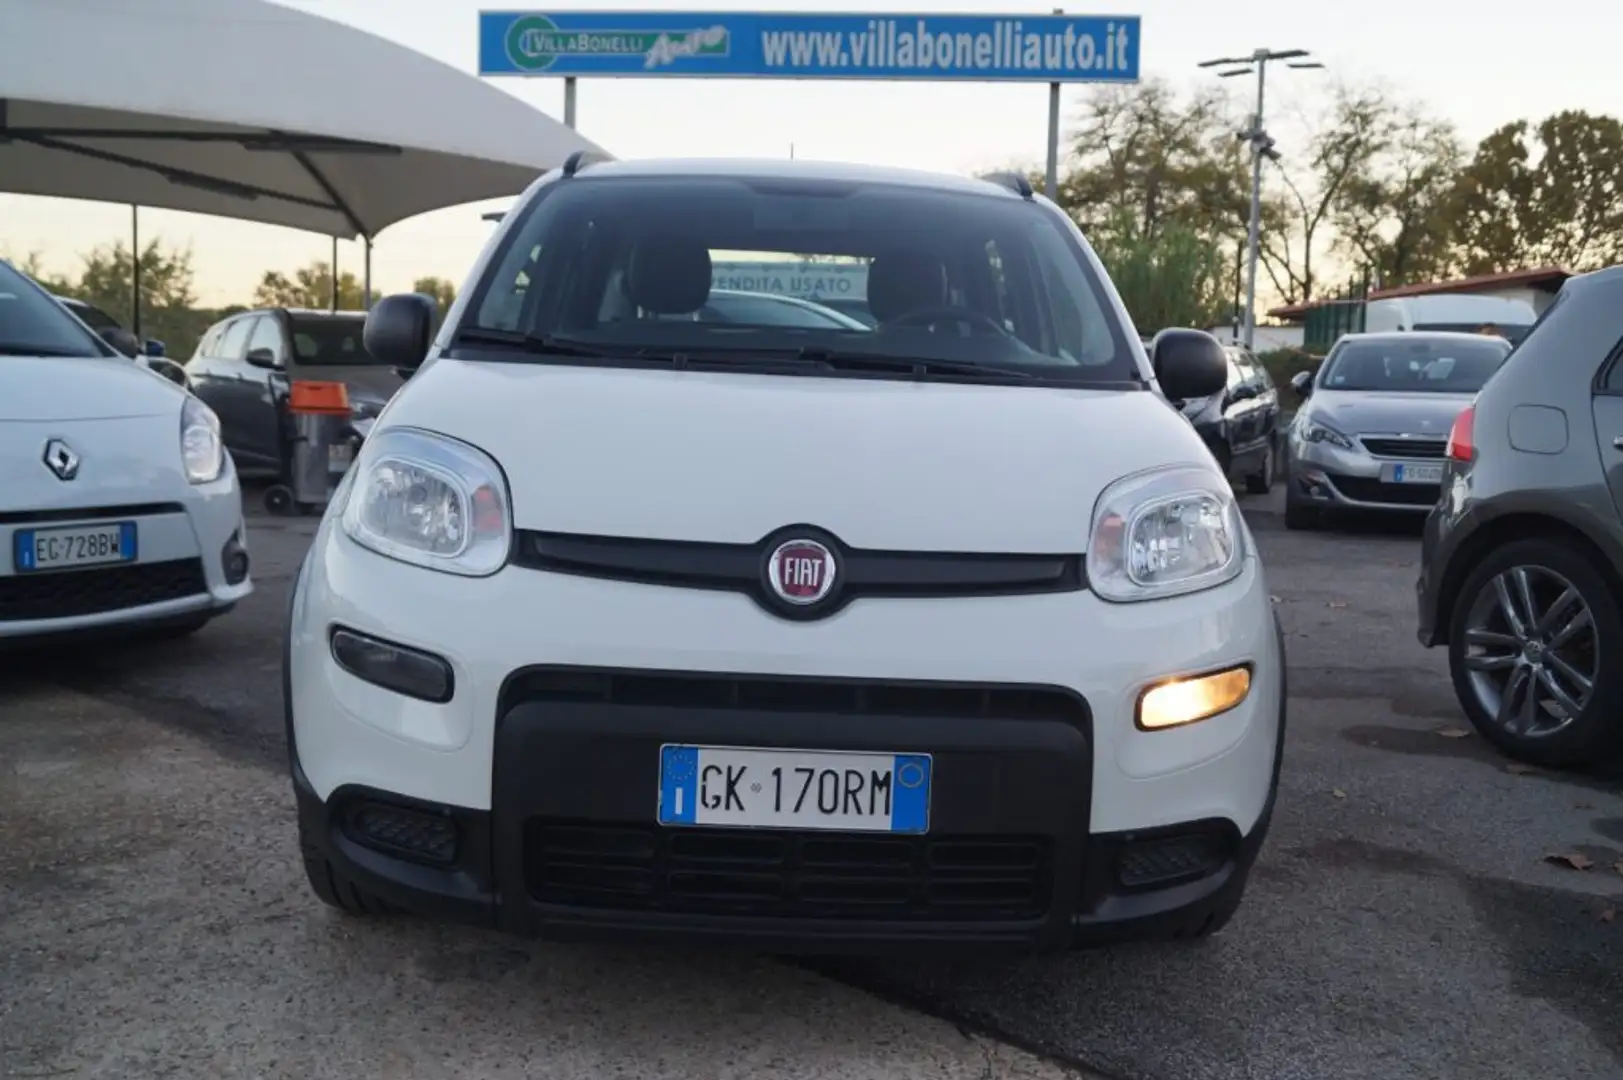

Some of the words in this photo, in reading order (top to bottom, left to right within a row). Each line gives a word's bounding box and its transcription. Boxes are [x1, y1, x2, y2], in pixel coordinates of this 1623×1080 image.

[762, 20, 1129, 70] www.villabonelliauto.it
[791, 277, 851, 293] USATO
[784, 557, 822, 587] FIAT
[701, 765, 748, 812] GK
[771, 766, 892, 816] 170RM
